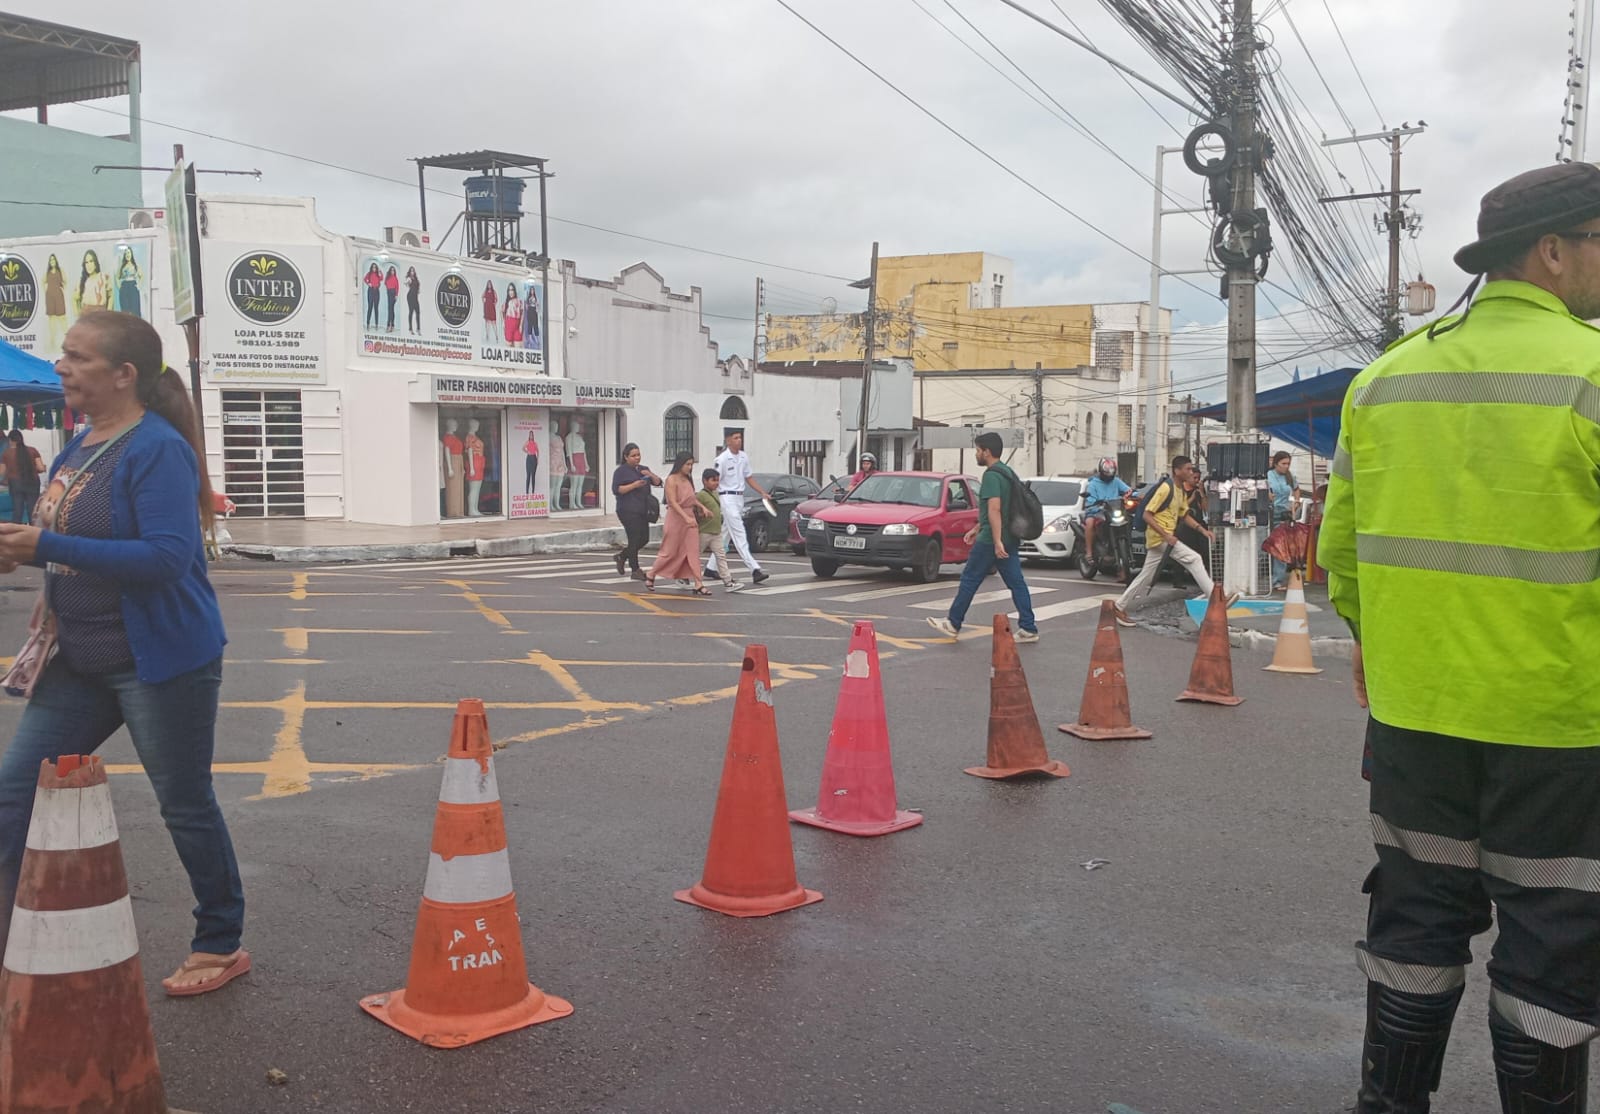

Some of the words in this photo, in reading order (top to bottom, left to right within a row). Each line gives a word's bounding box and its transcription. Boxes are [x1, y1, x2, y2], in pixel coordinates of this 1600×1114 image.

[0, 283, 32, 302] NTER
[235, 278, 296, 298] INTER
[240, 296, 290, 312] Fashion
[440, 291, 468, 308] INTER
[234, 329, 257, 338] LOJA
[481, 347, 503, 361] LOJA
[504, 349, 524, 363] PLUS
[525, 351, 542, 365] SIZE
[437, 378, 465, 392] INTER
[467, 380, 506, 393] FASHION
[508, 381, 562, 398] CONFECÇÕES
[576, 385, 594, 397] LOJA
[595, 386, 613, 398] PLUS
[614, 387, 631, 399] SIZE
